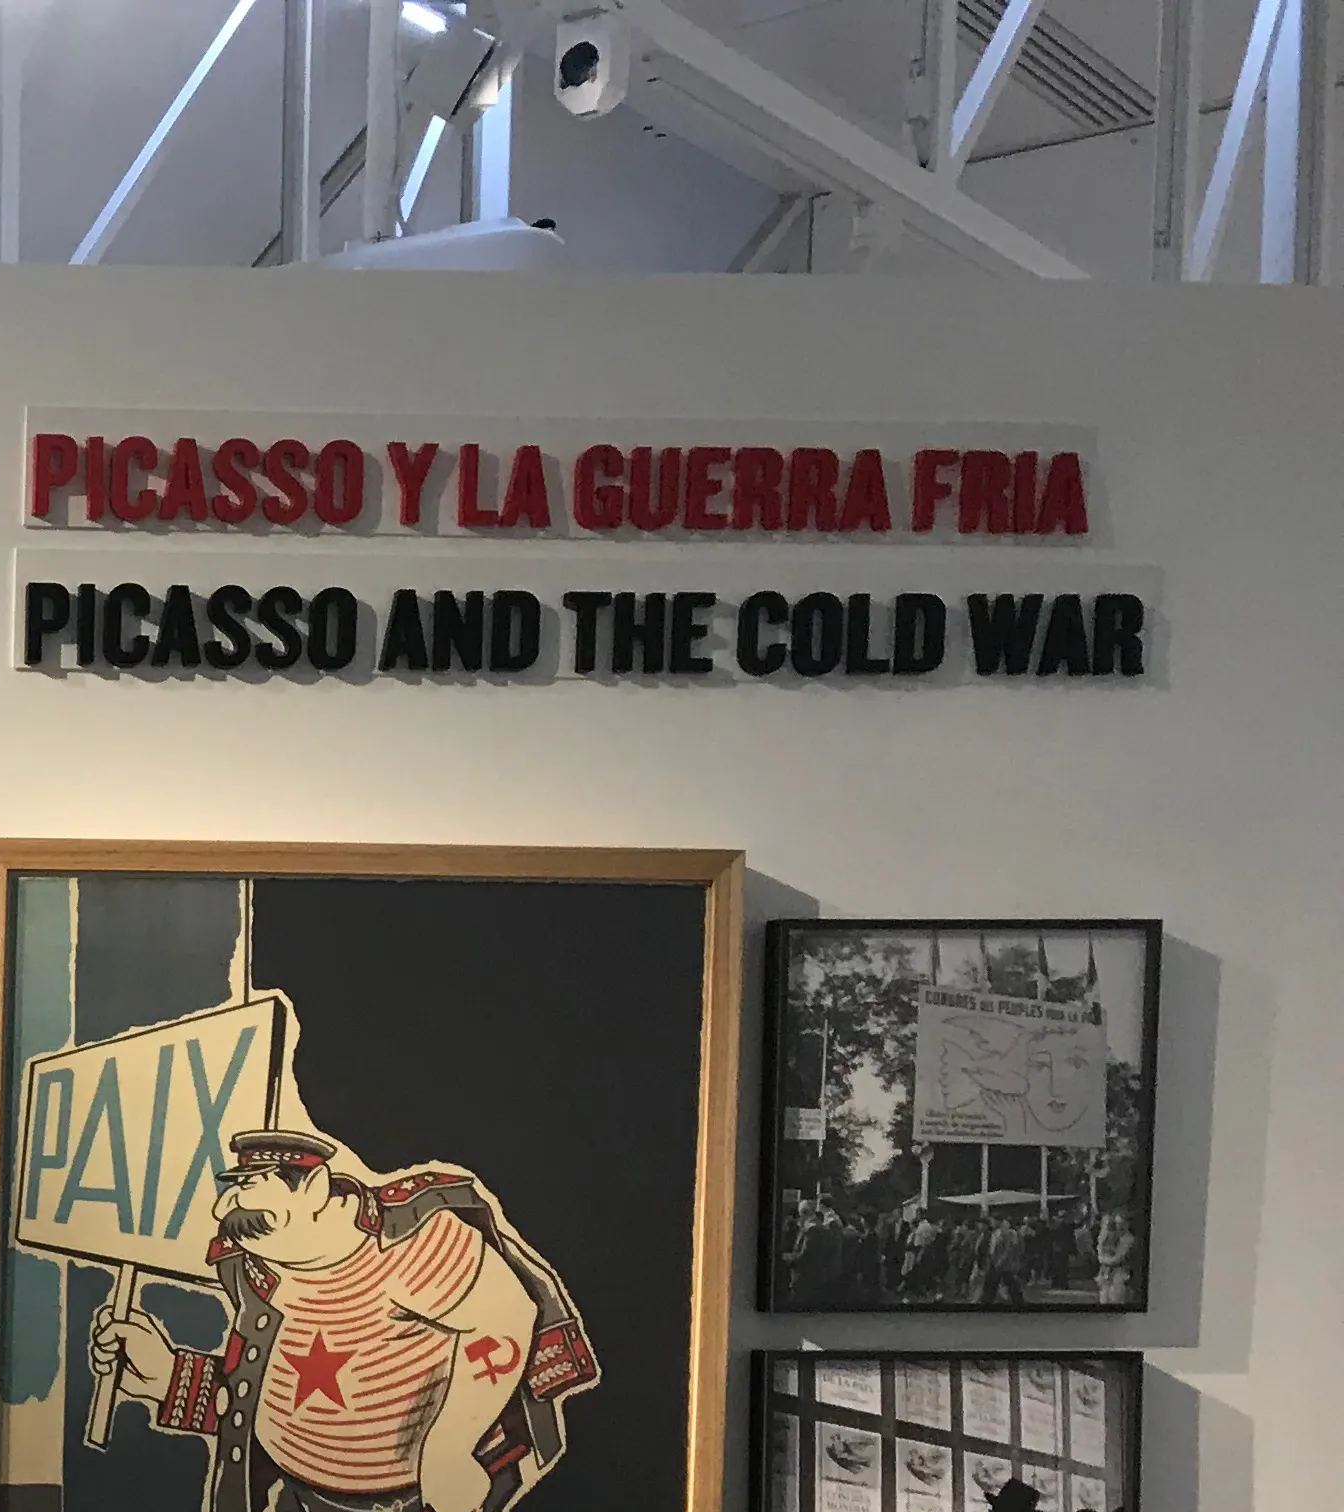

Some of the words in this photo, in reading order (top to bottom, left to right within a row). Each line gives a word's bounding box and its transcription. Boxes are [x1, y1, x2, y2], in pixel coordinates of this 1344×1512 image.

[31, 433, 364, 527] PICASSO
[388, 441, 439, 525] Y
[459, 445, 552, 528] LA
[573, 444, 890, 536] GUERRA
[909, 450, 1089, 536] FRIA
[25, 581, 358, 671] PICASSO
[379, 588, 541, 674] AND
[564, 591, 716, 674] THE
[737, 592, 946, 676] COLD
[967, 594, 1145, 678] WAR
[26, 1025, 258, 1240] PAIX
